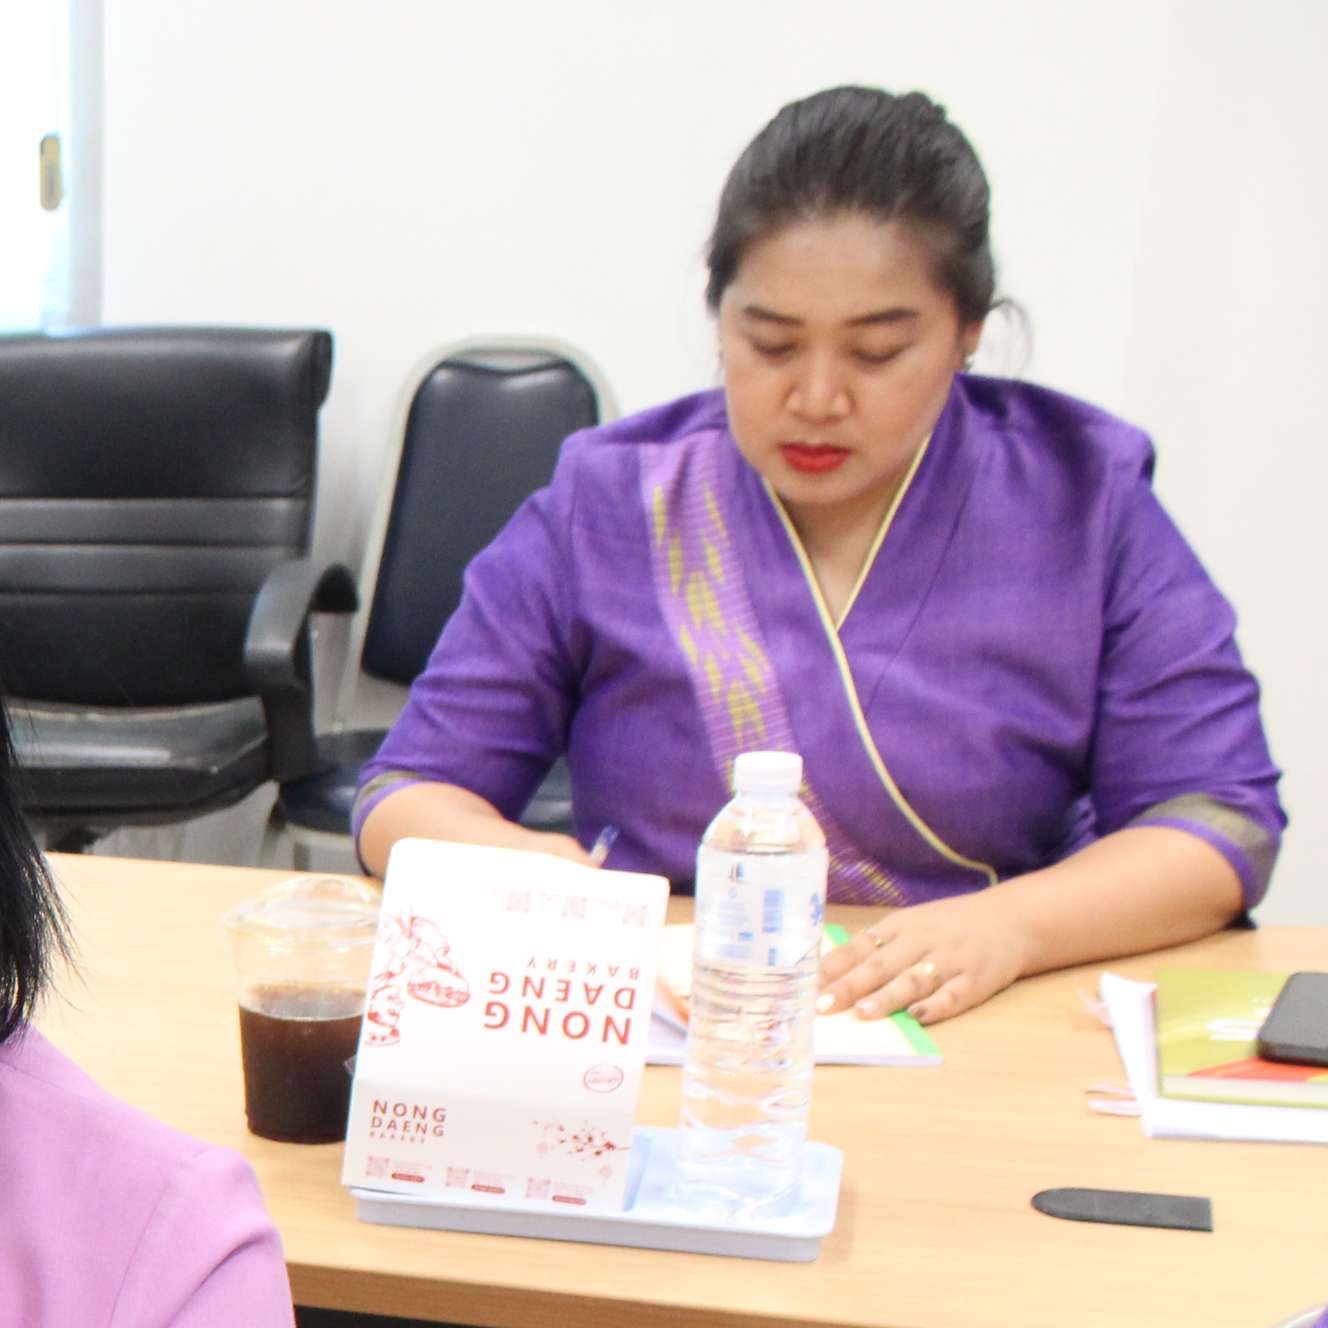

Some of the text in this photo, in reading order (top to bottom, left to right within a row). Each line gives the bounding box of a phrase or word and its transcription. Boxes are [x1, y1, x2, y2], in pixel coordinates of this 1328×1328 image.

[525, 955, 640, 980] BAKERY
[487, 971, 636, 1010] DAENG
[482, 1001, 632, 1045] NONG
[372, 1099, 447, 1123] NONG
[369, 1131, 427, 1144] BAKERY
[370, 1116, 445, 1137] DAENG
